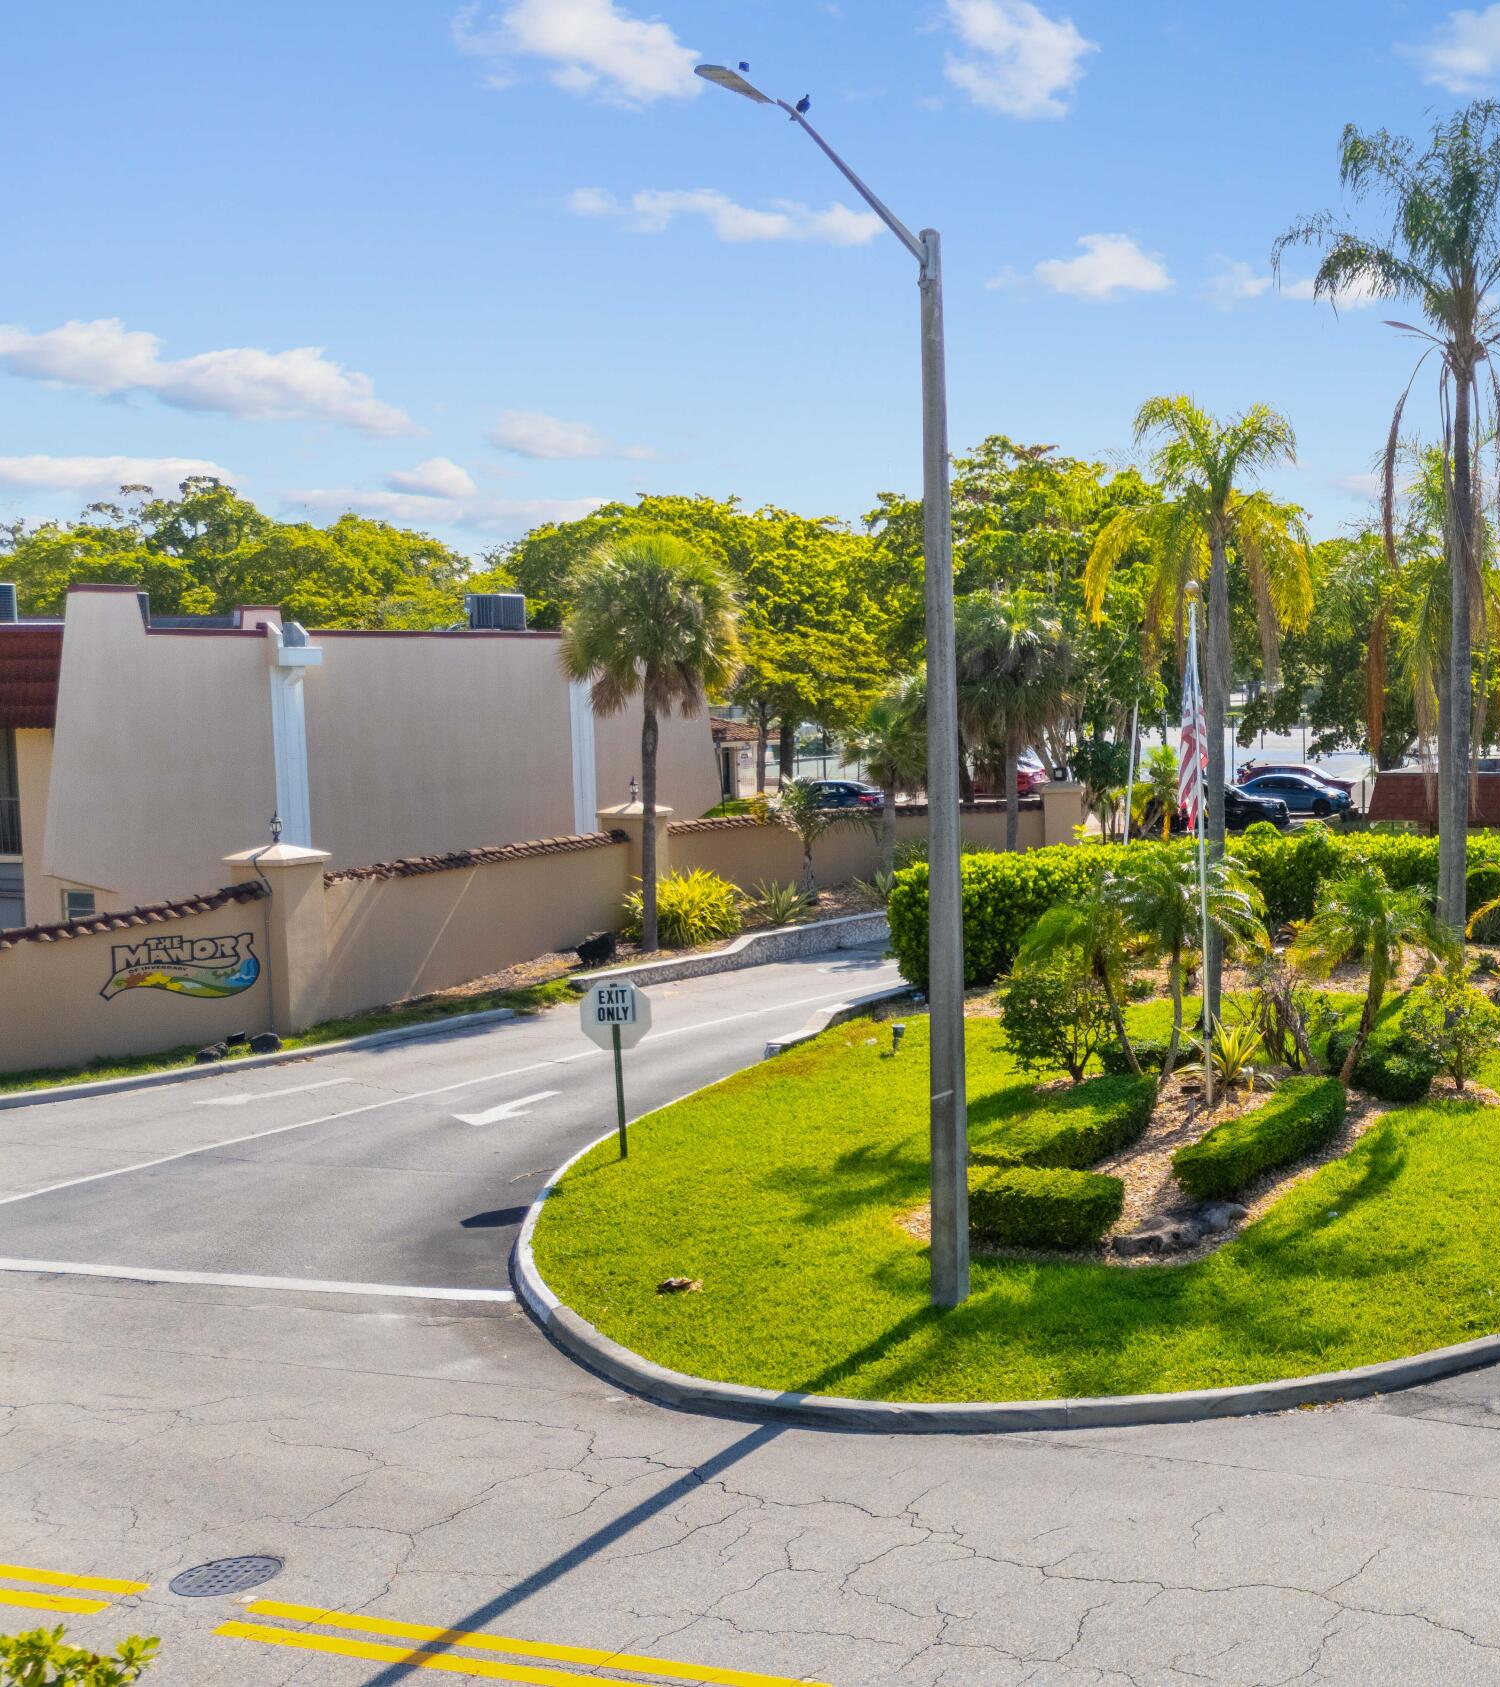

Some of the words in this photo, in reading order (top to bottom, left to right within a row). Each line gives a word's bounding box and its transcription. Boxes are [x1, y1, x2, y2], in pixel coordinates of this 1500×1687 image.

[144, 935, 183, 949] THE
[112, 932, 254, 974] MANORS
[598, 989, 627, 1004] EXIT
[598, 1007, 629, 1021] ONLY
